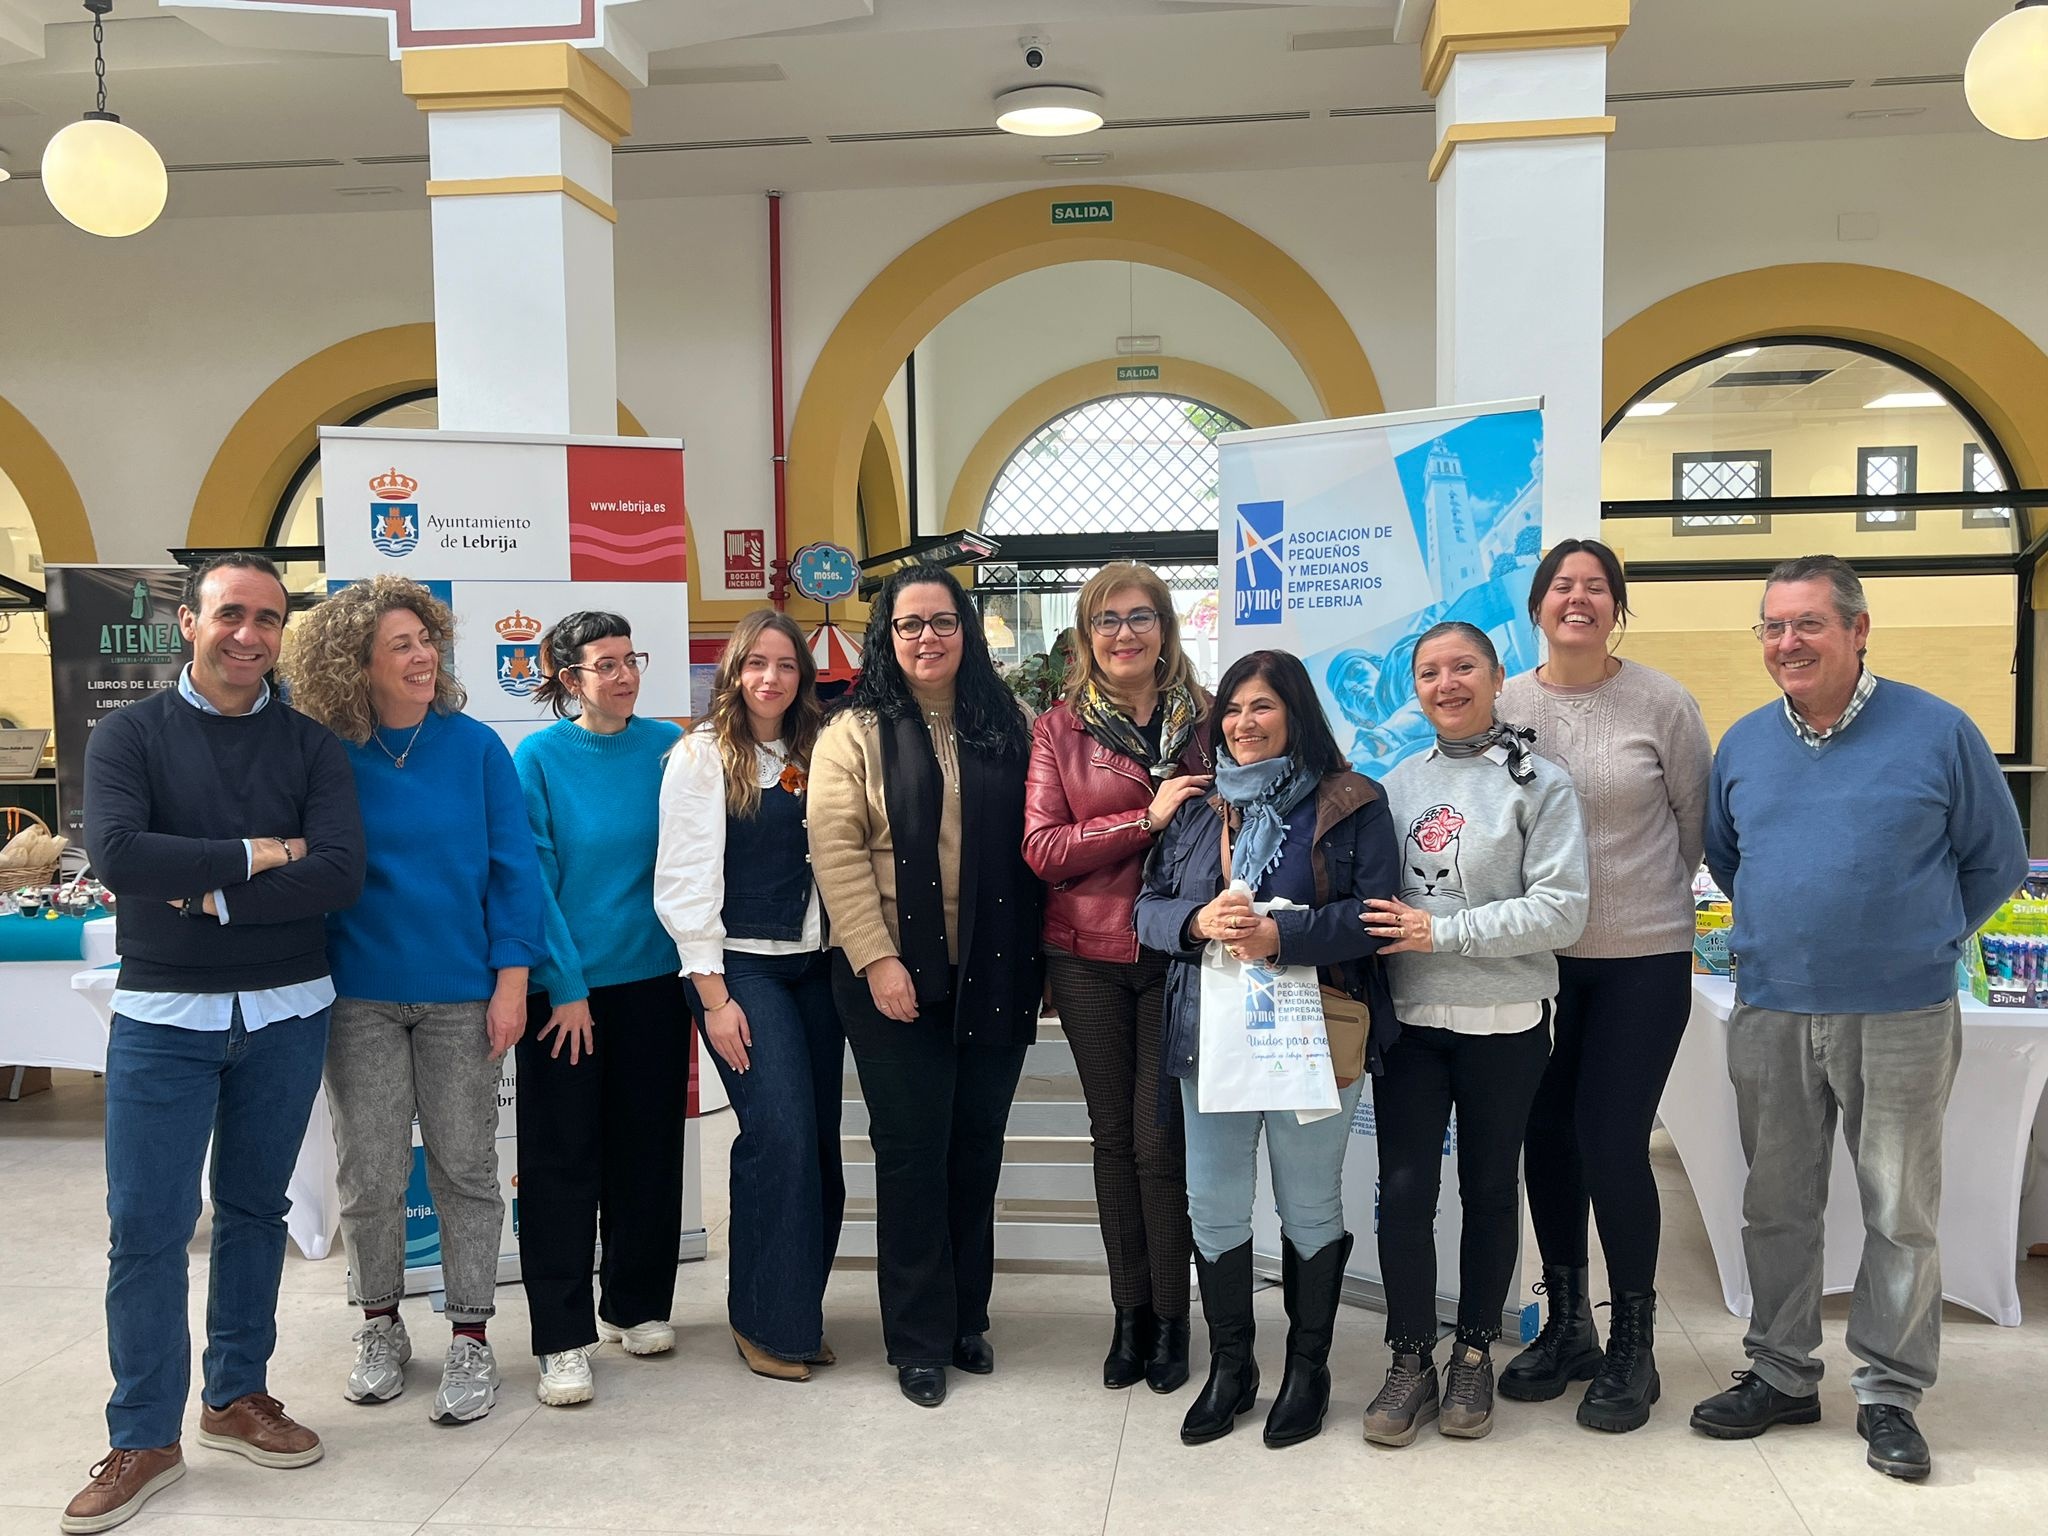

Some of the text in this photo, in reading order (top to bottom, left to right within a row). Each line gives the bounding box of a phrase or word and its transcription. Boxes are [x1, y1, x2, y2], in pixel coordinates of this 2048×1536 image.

[1055, 206, 1109, 219] SALIDA
[1119, 368, 1157, 378] SALIDA
[590, 500, 666, 515] www.lebrija.es
[427, 514, 531, 532] Ayuntamiento
[1288, 526, 1392, 544] ASOCIACION DE
[440, 534, 517, 552] de Lebrija
[1288, 544, 1360, 560] PEQUEÑOS
[814, 571, 843, 580] moses.
[1288, 561, 1369, 576] Y MEDIANOS
[1288, 577, 1382, 593] EMPRESARIOS
[1236, 588, 1281, 618] pyme
[1288, 595, 1363, 609] DE LEBRIJA
[100, 624, 182, 653] ATENEA
[87, 680, 177, 689] LIBROS DE LECT
[1247, 1033, 1329, 1048] Unidos para cre
